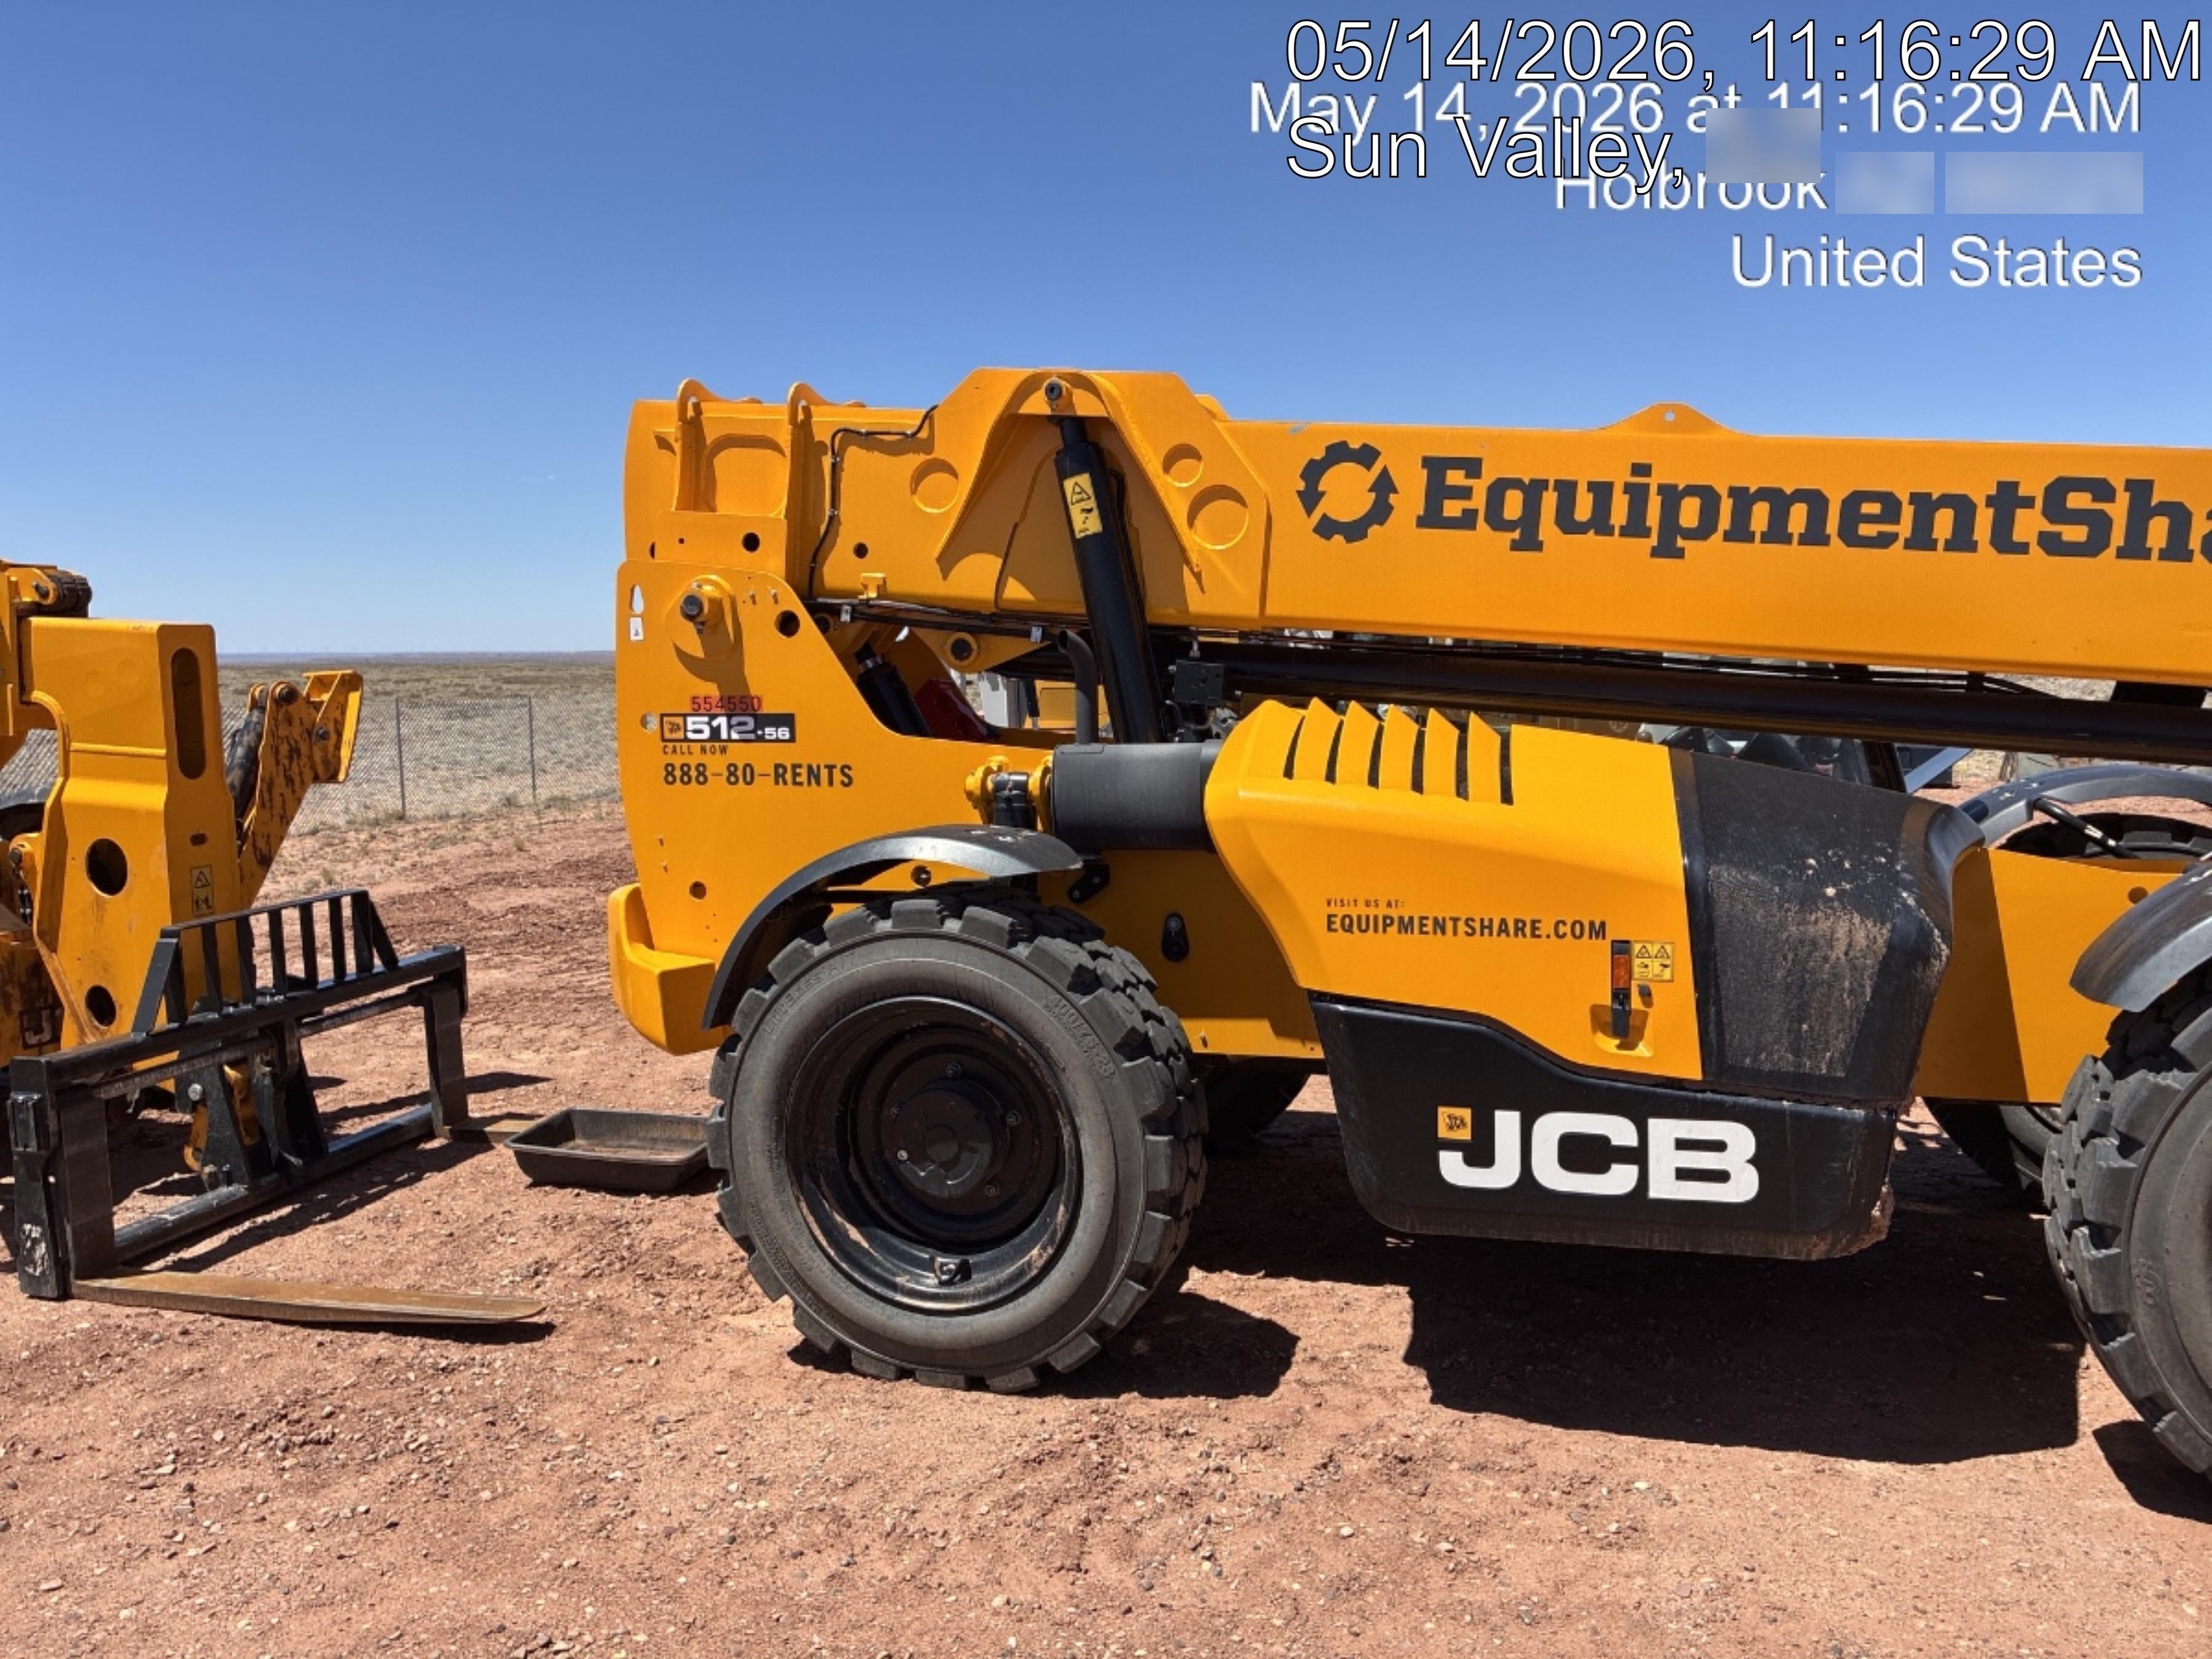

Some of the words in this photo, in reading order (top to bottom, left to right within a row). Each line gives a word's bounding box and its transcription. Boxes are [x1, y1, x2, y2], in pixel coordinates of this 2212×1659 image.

[1415, 455, 2212, 564] EquipmentSh
[691, 696, 761, 713] 554550
[662, 744, 694, 755] CALL
[700, 744, 728, 755] NOW
[663, 762, 854, 788] 888-80-RENTS
[1326, 898, 1359, 908] VISIT
[1364, 899, 1380, 909] US
[1386, 900, 1405, 909] AT:
[1326, 914, 1607, 941] EQUIPMENTSHARE.COM
[1438, 1109, 1760, 1203] JCB
